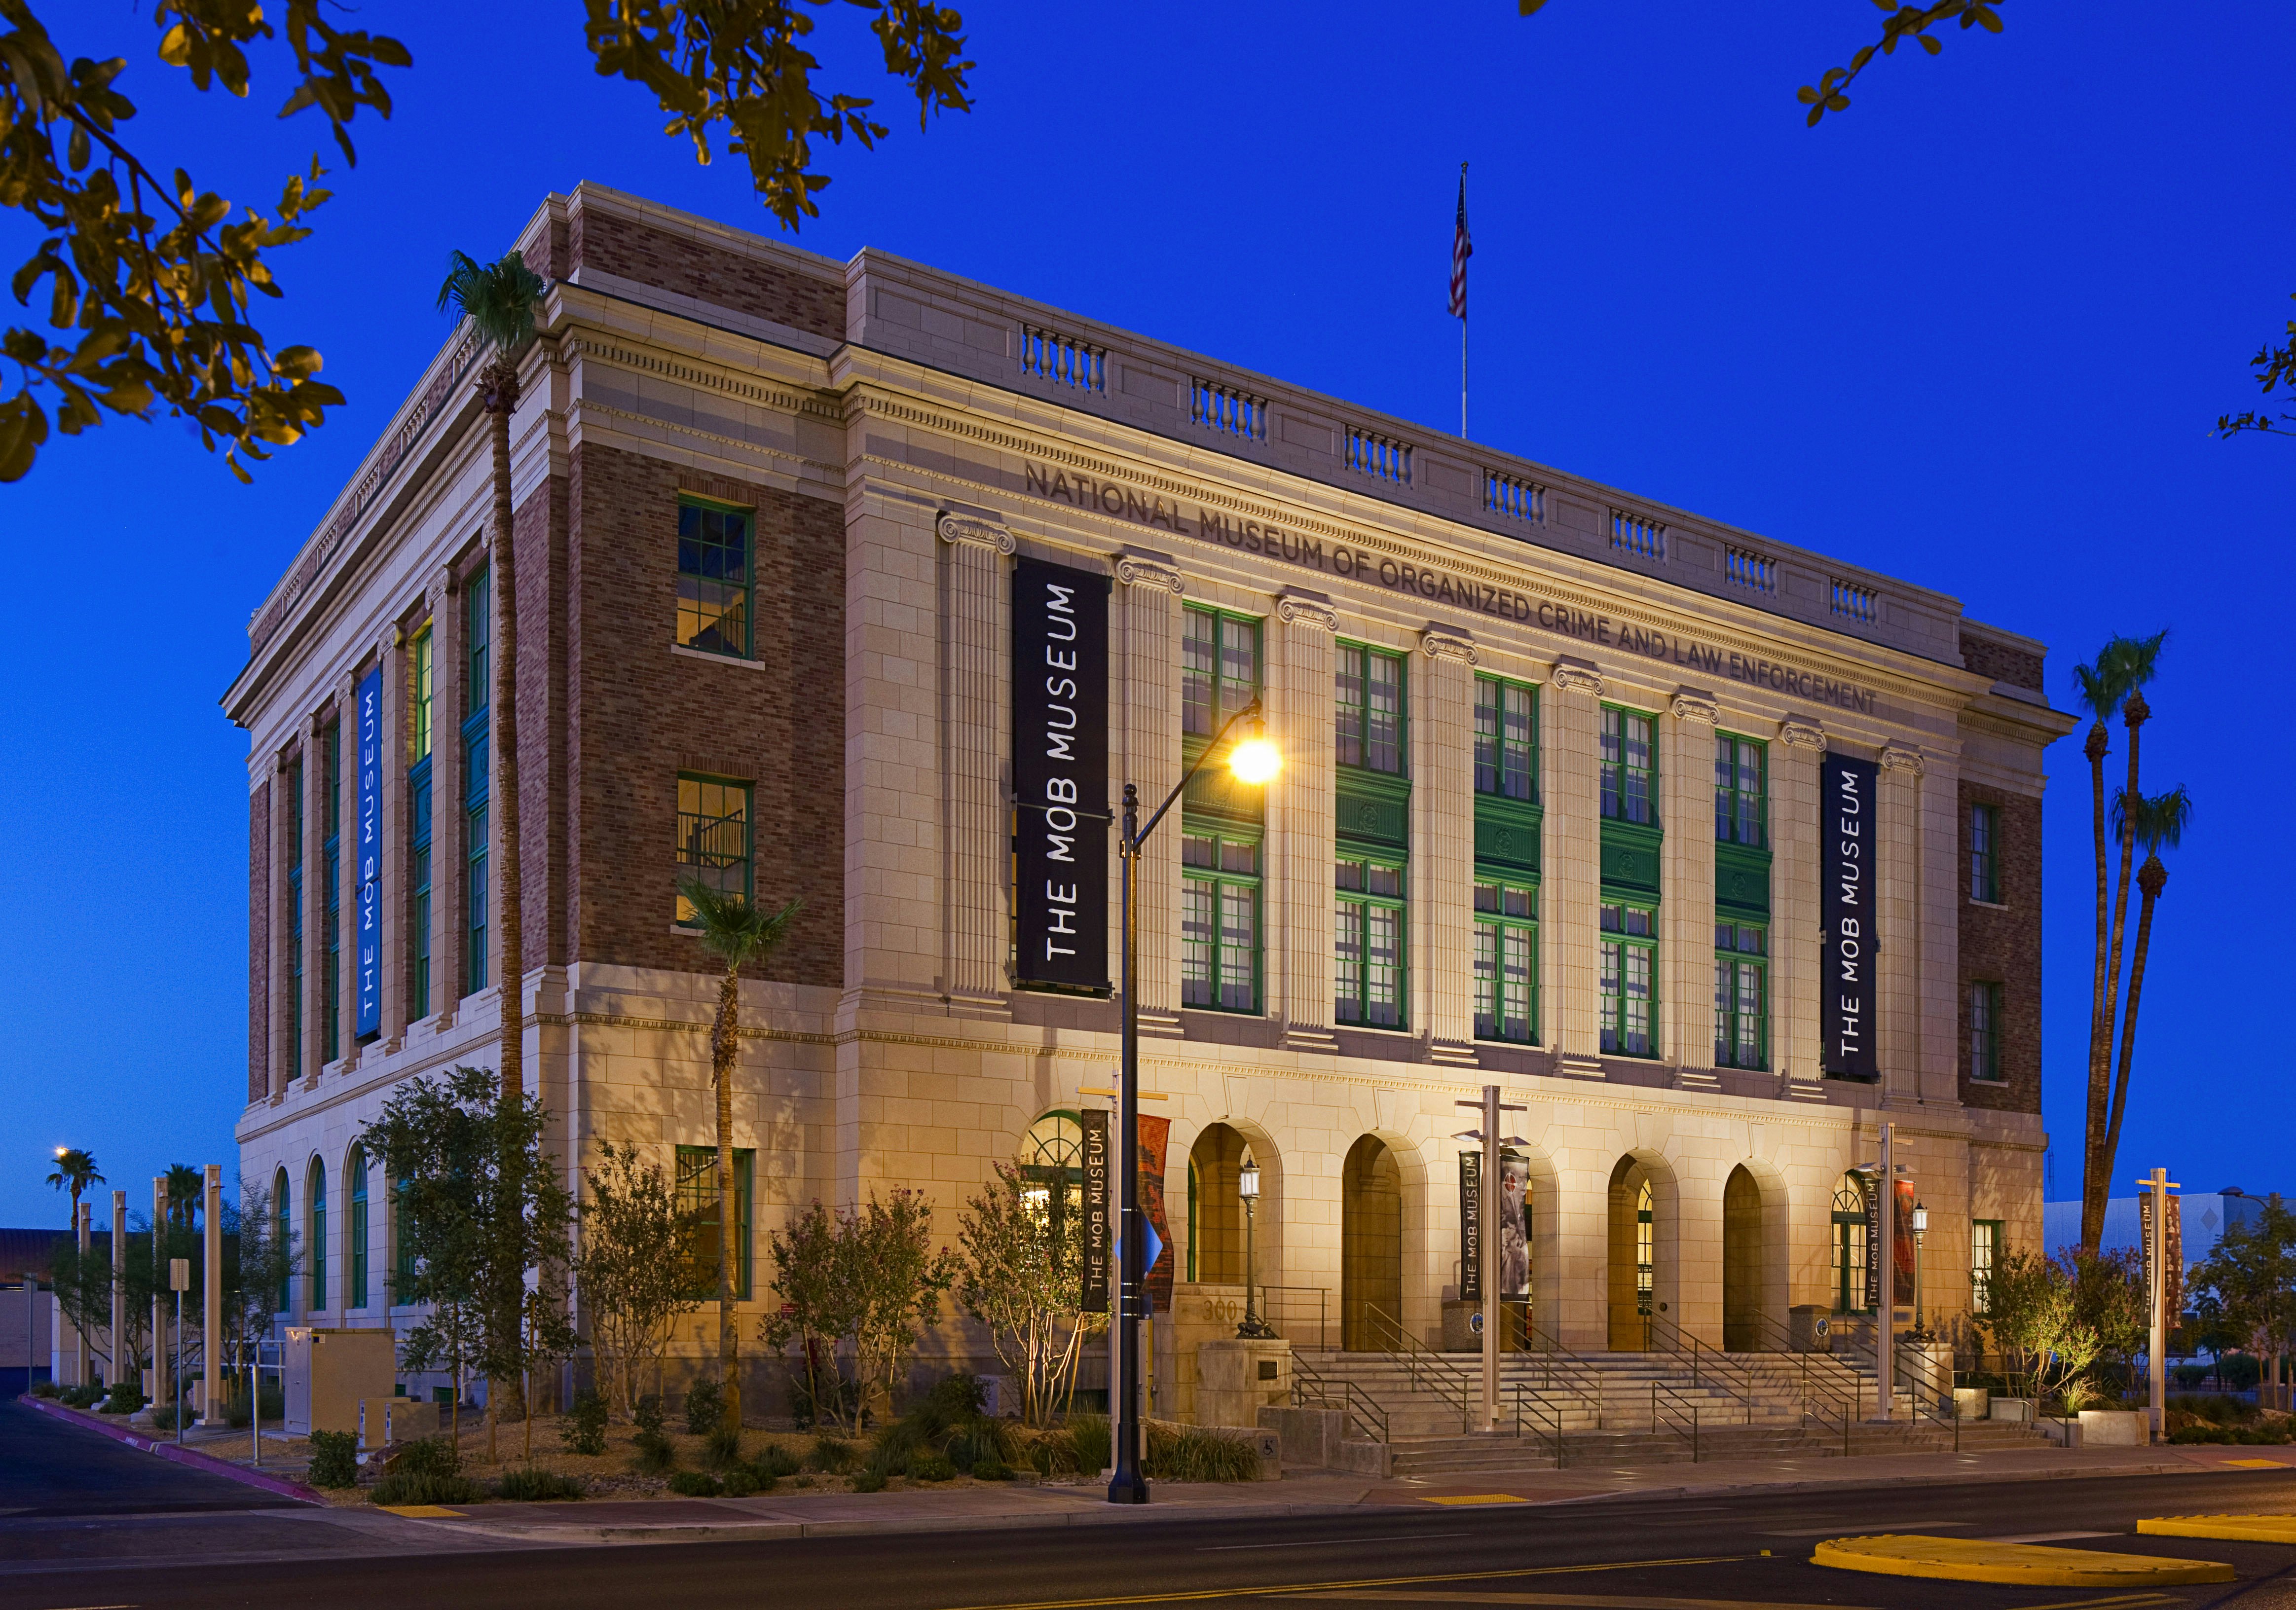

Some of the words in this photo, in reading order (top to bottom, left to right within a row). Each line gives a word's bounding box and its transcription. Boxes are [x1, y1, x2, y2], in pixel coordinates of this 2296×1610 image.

[1027, 461, 1188, 533] NATIONAL
[1200, 508, 1322, 568] MUSEUM
[1333, 548, 1370, 578] OF
[1379, 556, 1529, 620] ORGANIZED
[1538, 604, 1610, 644] CRIME
[1618, 625, 1666, 657] AND
[1674, 639, 1722, 672] LAW
[1729, 654, 1877, 714] ENFORCEMENT
[1046, 584, 1076, 761] MUSEUM
[365, 691, 373, 843] MUSEUM
[1046, 777, 1076, 862] MOB
[1841, 770, 1859, 905] MUSEUM
[365, 856, 373, 930] MOB
[1047, 879, 1076, 961] THE
[364, 945, 373, 1017] THE
[1841, 917, 1859, 982] MOB
[1841, 994, 1859, 1057] THE
[1089, 1130, 1104, 1204] MUSEUM
[1465, 1156, 1478, 1220] MUSEUM
[1091, 1211, 1103, 1247] MOB
[1467, 1226, 1478, 1257] MOB
[1867, 1183, 1879, 1238] MUSEUM
[2143, 1205, 2151, 1255] MUSEUM
[1090, 1255, 1103, 1290] THE
[1466, 1264, 1477, 1294] THE
[1869, 1276, 1878, 1301] THE
[1203, 1300, 1237, 1320] 300
